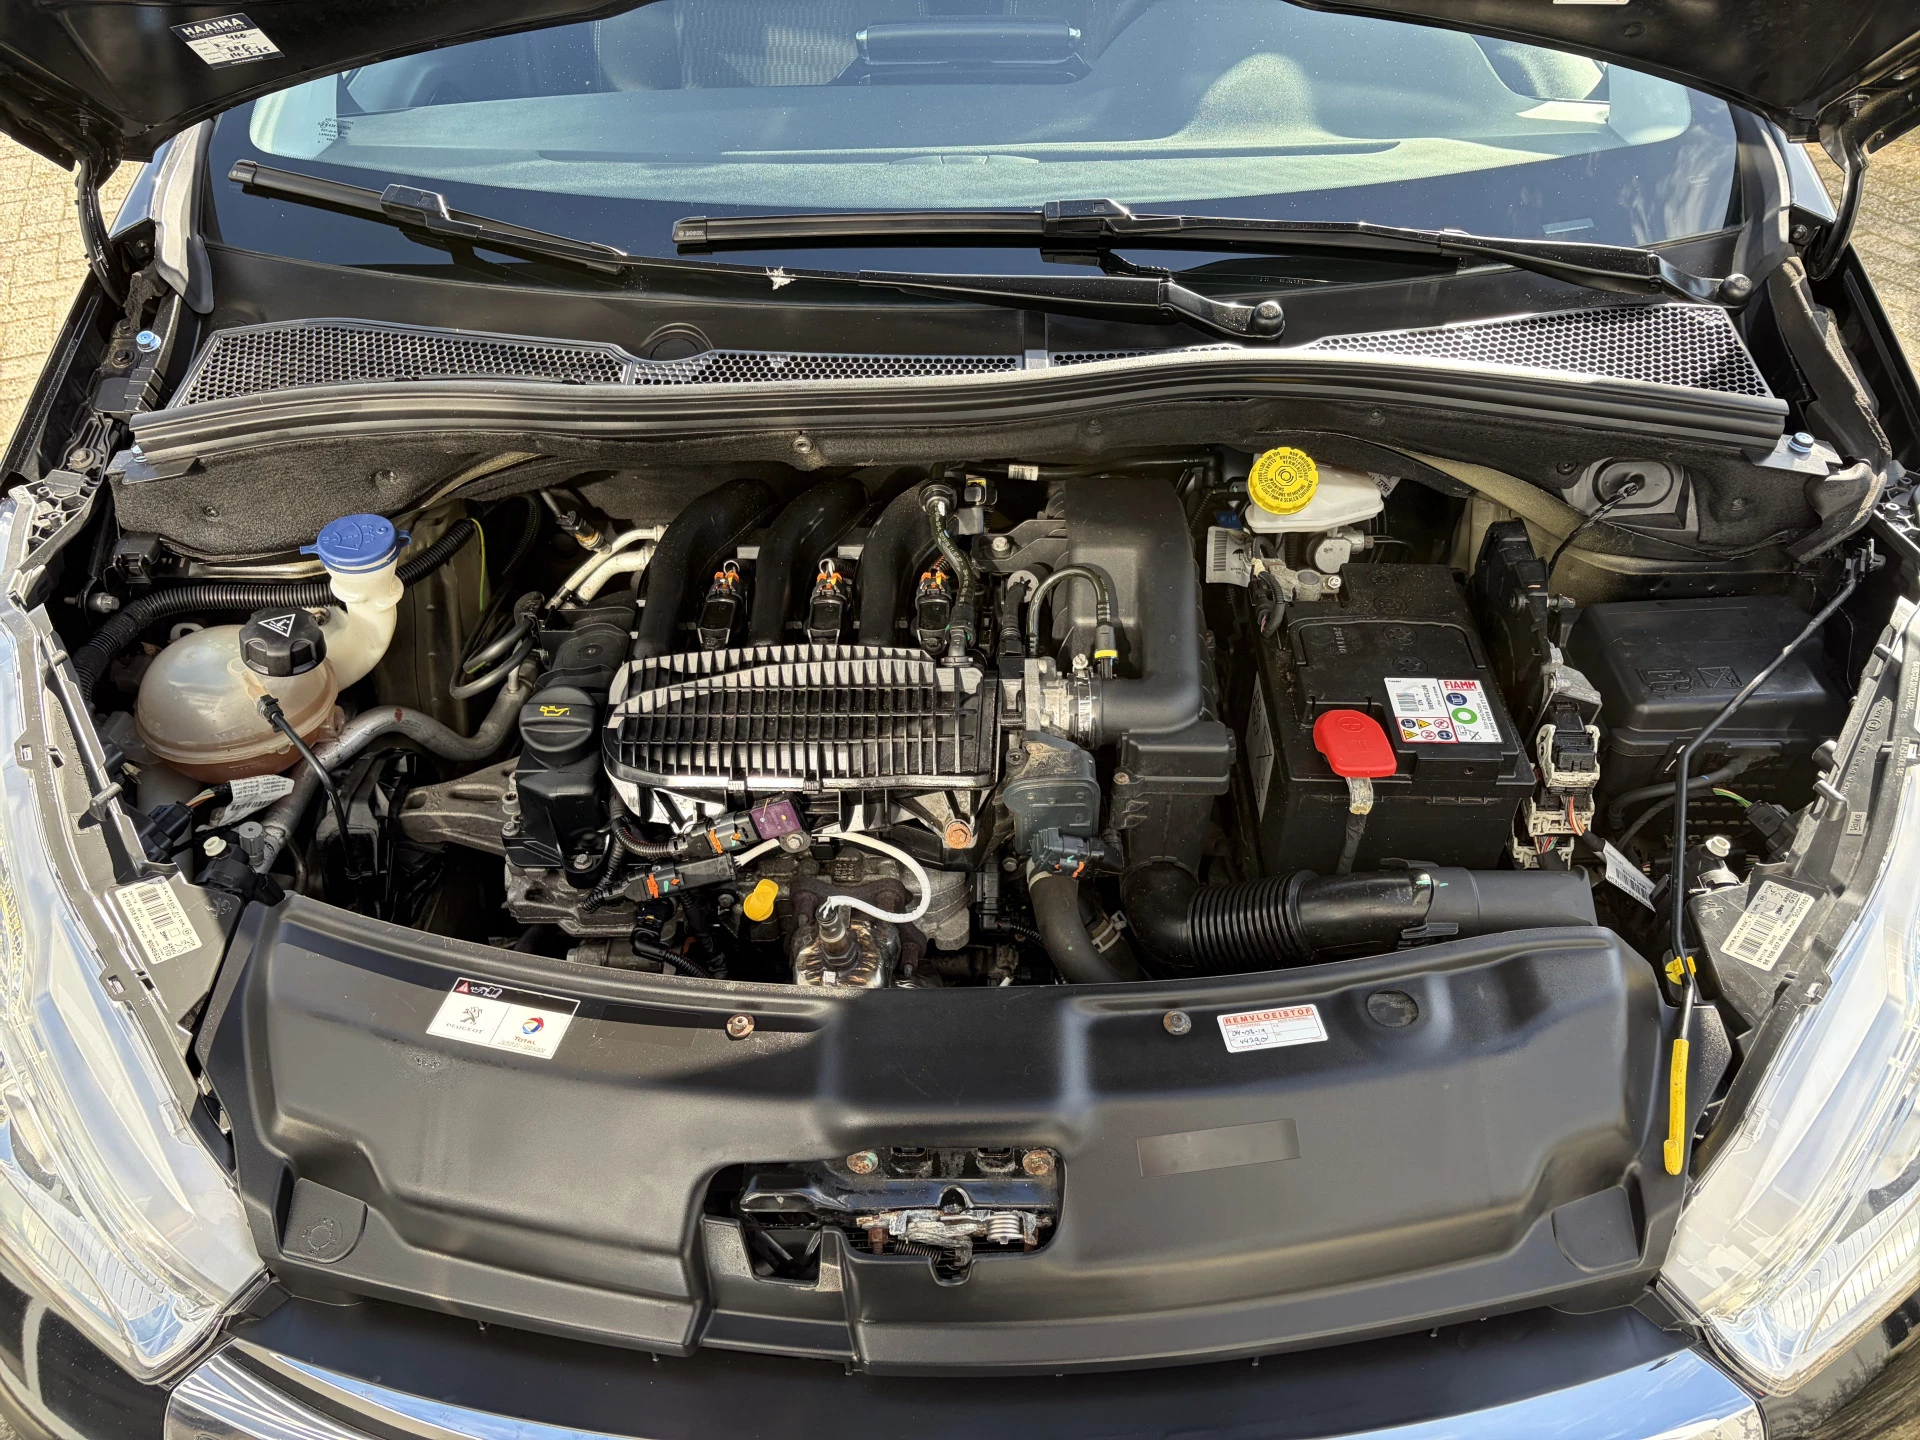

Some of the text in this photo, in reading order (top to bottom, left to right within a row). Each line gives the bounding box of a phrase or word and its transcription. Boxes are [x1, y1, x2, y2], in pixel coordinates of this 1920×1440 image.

[182, 18, 244, 36] HAAIMA
[189, 31, 215, 39] SERVICE
[1444, 681, 1478, 690] FIAMM
[1849, 813, 1862, 833] Valeo
[1225, 1008, 1312, 1024] REMVLOEISTOF
[446, 1023, 484, 1034] PEUGEOT
[514, 1036, 537, 1046] TOTAL
